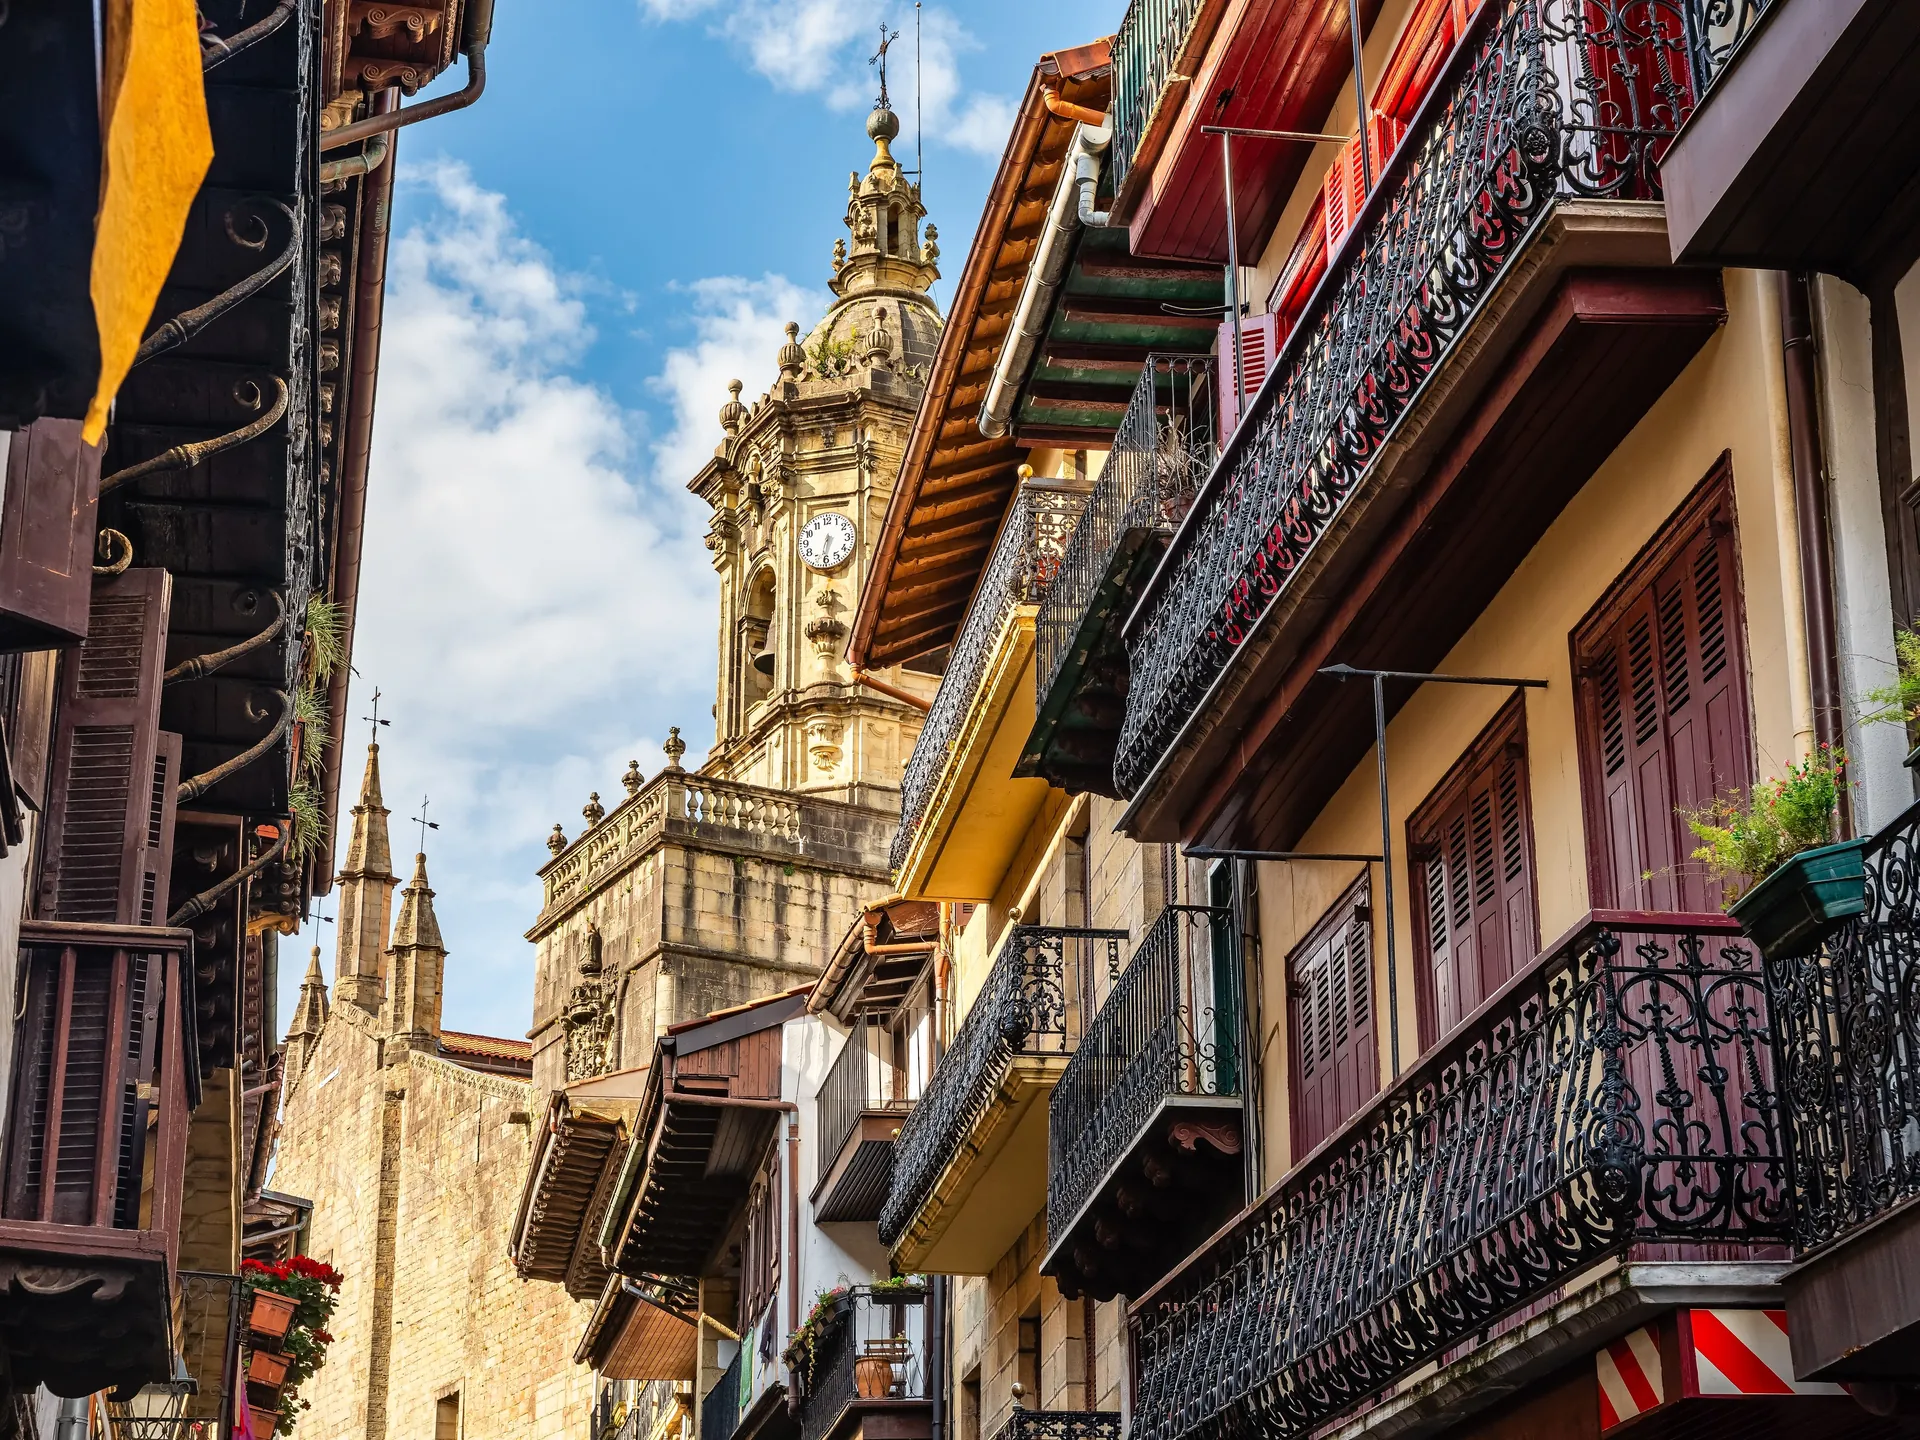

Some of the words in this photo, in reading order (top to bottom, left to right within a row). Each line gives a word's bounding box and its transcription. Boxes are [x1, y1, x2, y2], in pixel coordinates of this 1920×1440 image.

[823, 517, 832, 525] 12
[814, 522, 820, 530] 11
[841, 523, 847, 531] 2
[806, 529, 813, 538] 10
[844, 533, 851, 541] 3
[803, 540, 809, 548] 9
[841, 544, 847, 552] 4
[806, 548, 812, 556] 8
[833, 551, 840, 560] 5
[823, 555, 829, 564] 6
